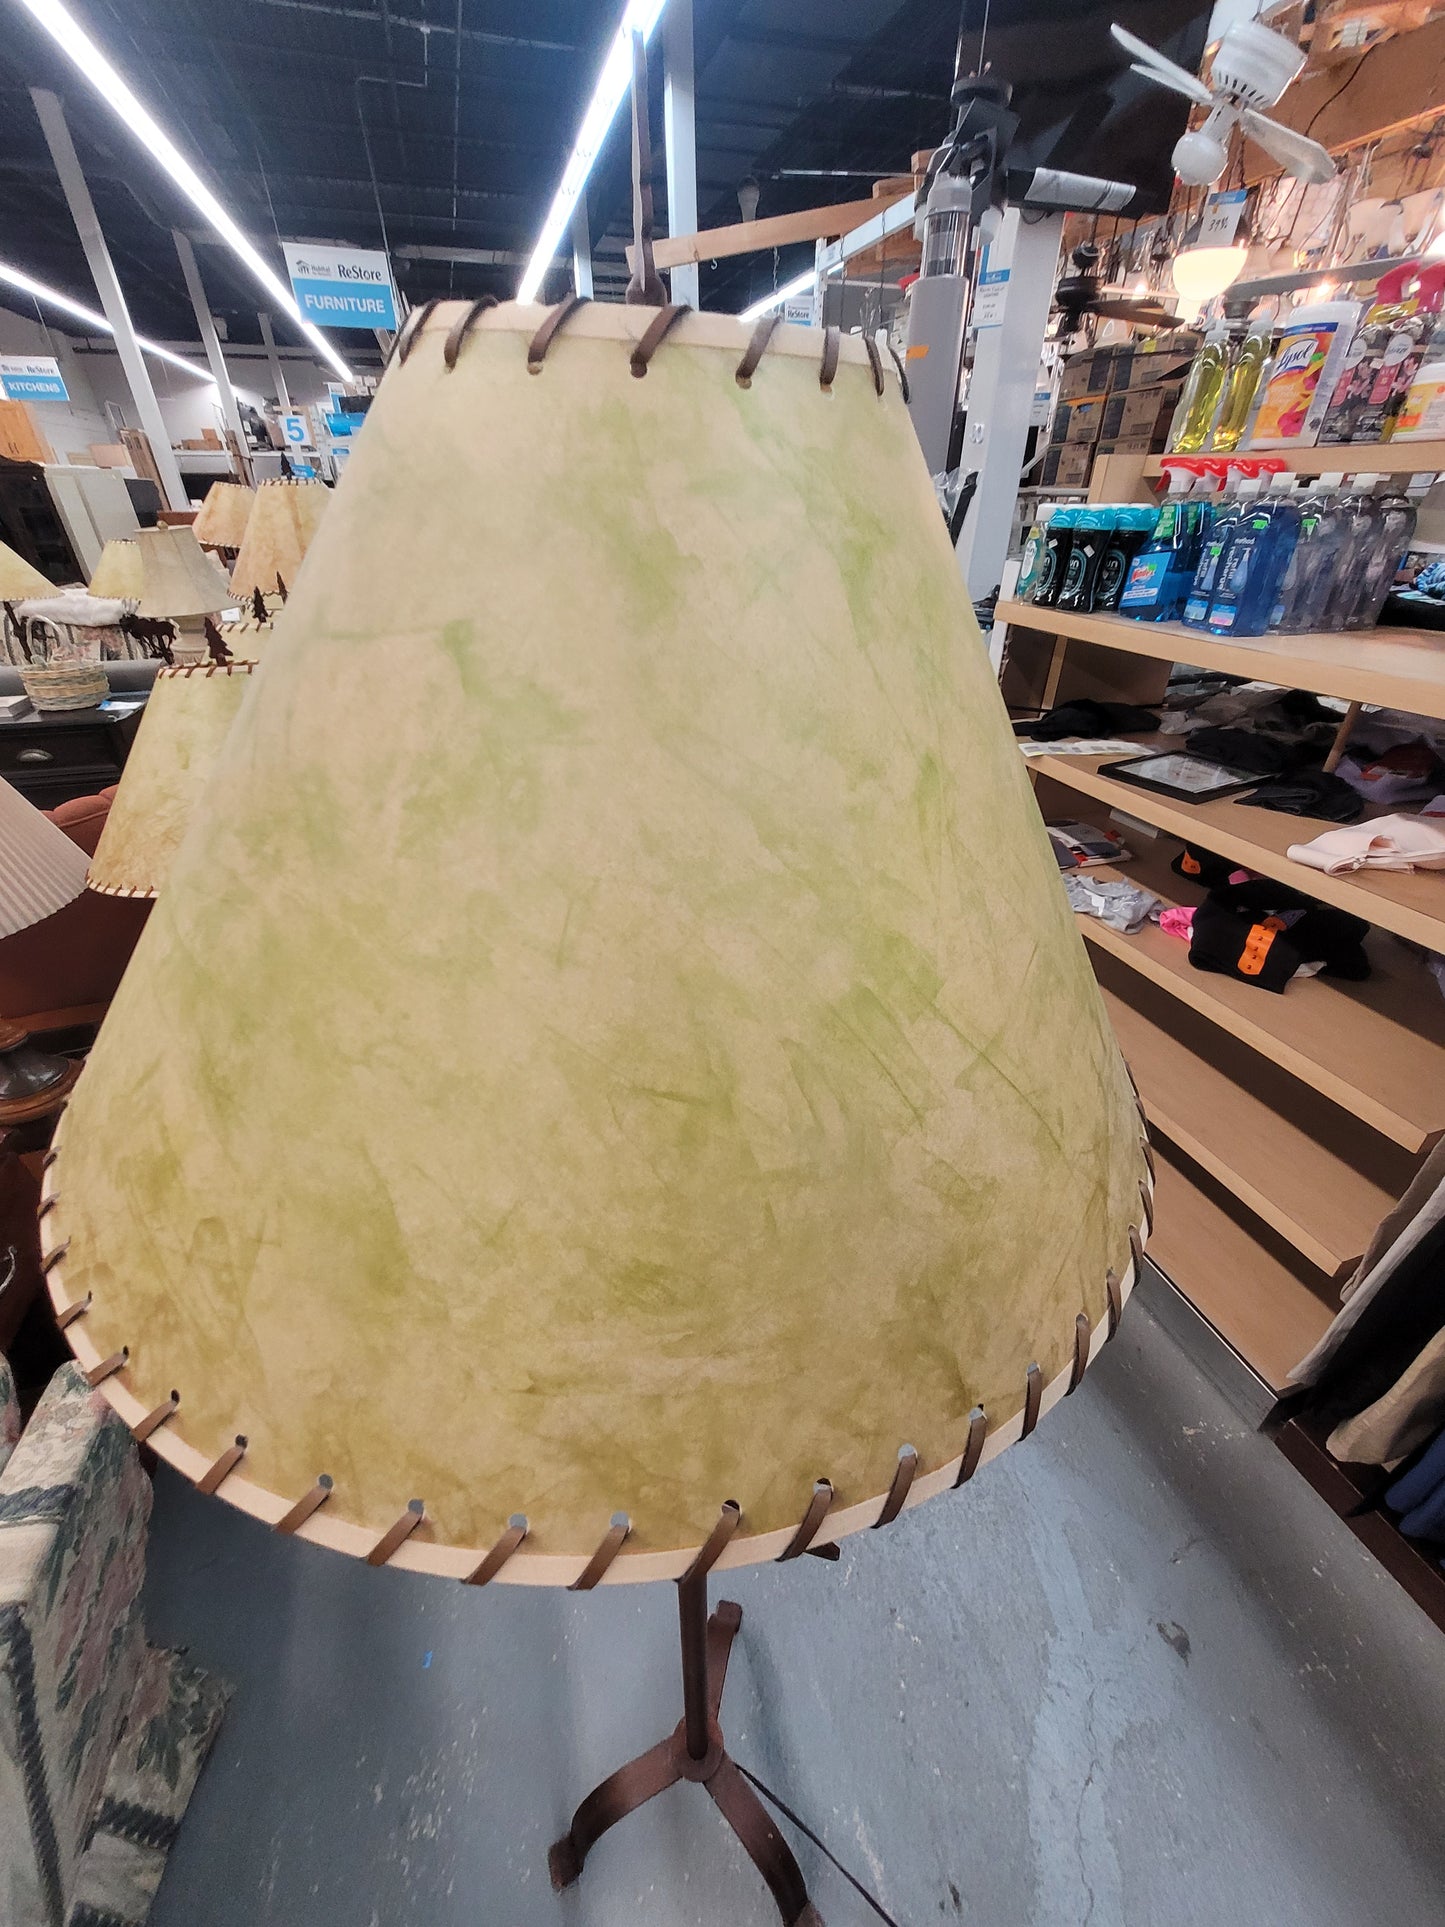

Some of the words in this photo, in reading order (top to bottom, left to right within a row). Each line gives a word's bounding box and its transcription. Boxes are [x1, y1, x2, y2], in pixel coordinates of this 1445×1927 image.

[337, 264, 382, 281] ReStore
[304, 293, 386, 314] FURNITURE
[787, 310, 810, 319] ReStore
[8, 382, 60, 393] KITCHENS
[286, 418, 304, 442] 5
